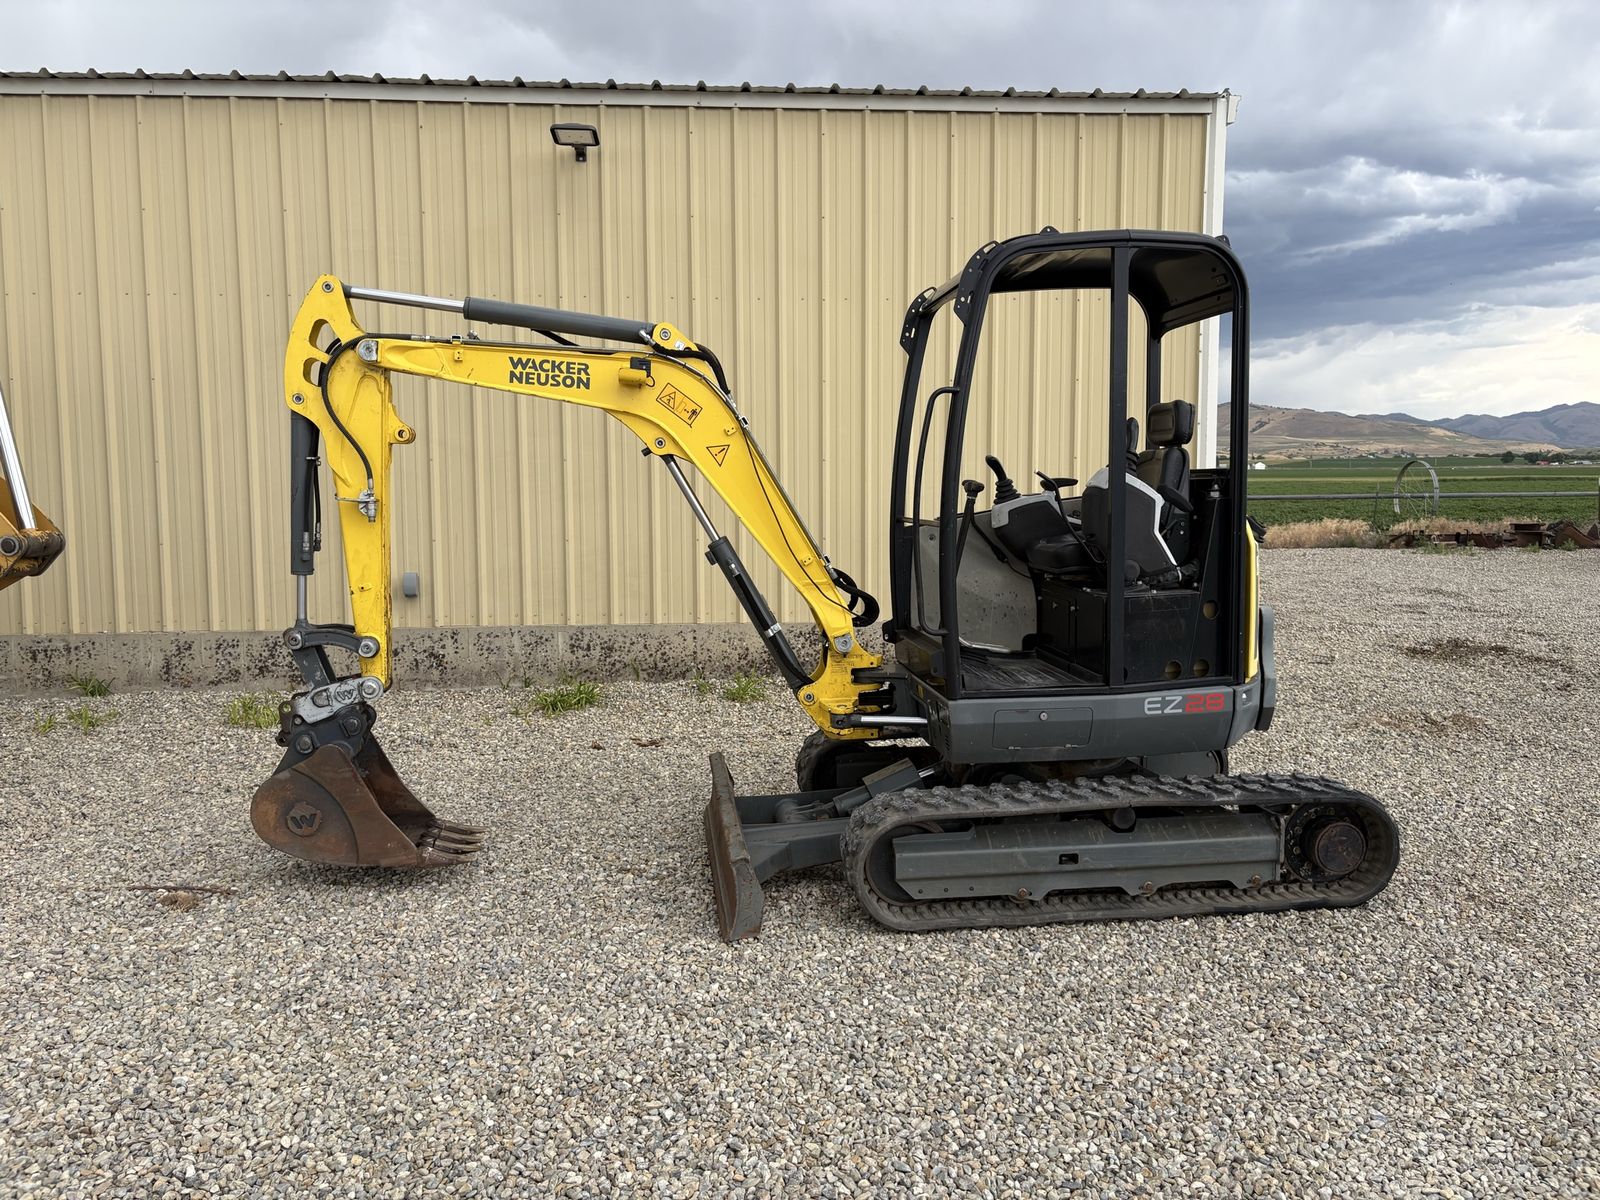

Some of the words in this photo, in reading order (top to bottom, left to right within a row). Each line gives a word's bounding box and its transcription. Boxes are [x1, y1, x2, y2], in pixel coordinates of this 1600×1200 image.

[508, 356, 591, 376] WACKER
[509, 370, 591, 390] NEUSON
[1144, 693, 1225, 715] EZ28
[290, 813, 318, 830] W
